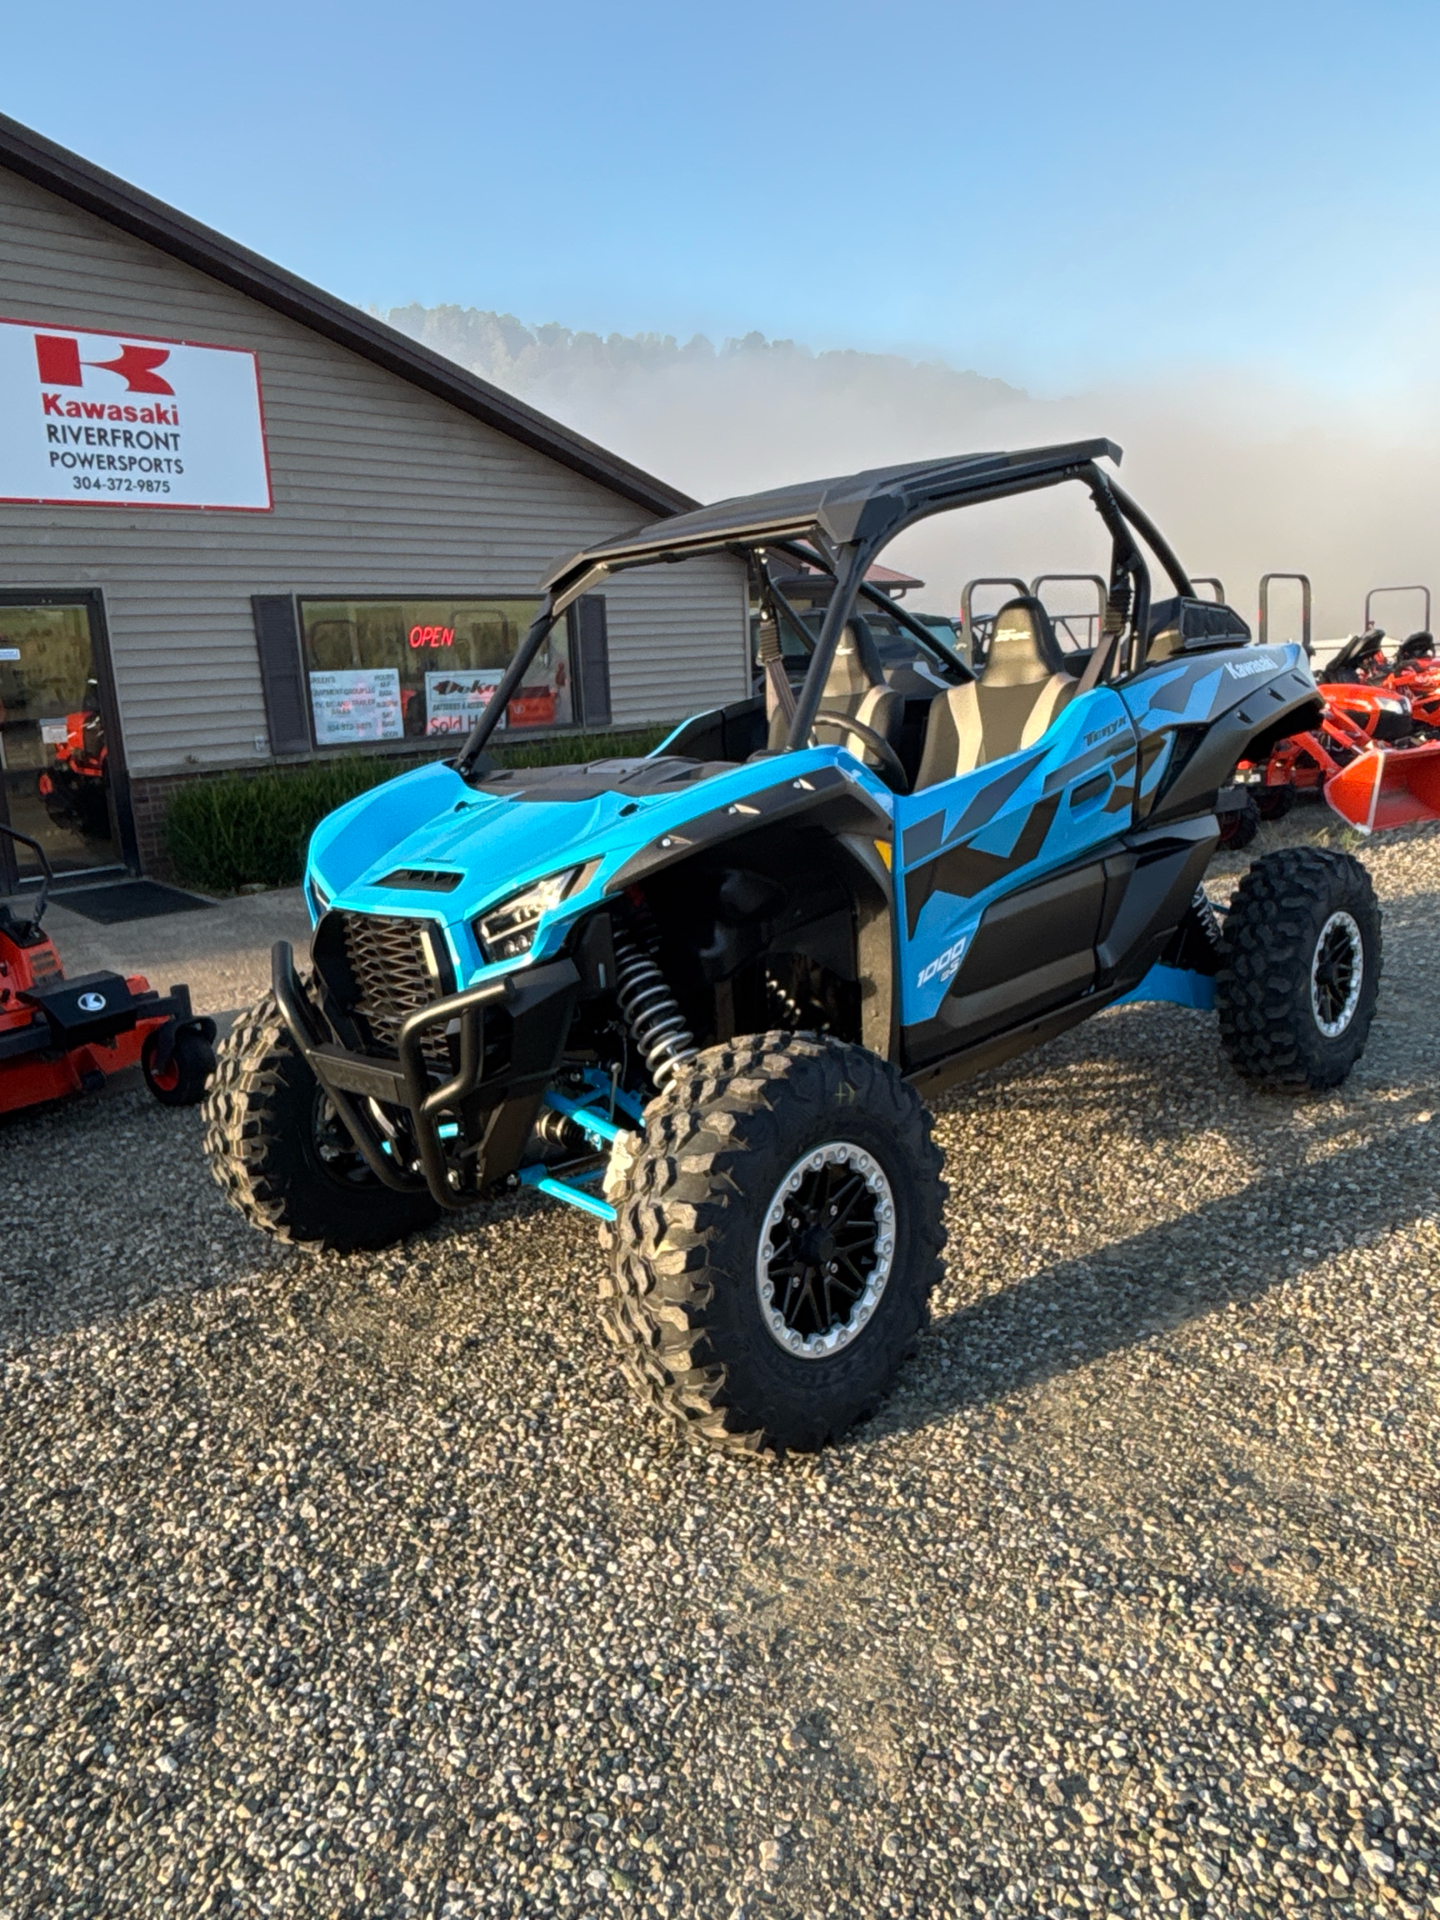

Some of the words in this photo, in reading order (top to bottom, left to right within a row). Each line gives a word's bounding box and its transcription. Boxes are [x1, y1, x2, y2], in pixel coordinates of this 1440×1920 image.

[41, 392, 180, 426] Kawasaki
[46, 424, 181, 451] RIVERFRONT
[49, 451, 184, 474] POWERSPORTS
[73, 476, 171, 493] 304-372-9875
[409, 625, 455, 648] OPEN
[1223, 653, 1279, 680] Kawasaki
[430, 714, 463, 735] Sold
[917, 936, 967, 989] 1000
